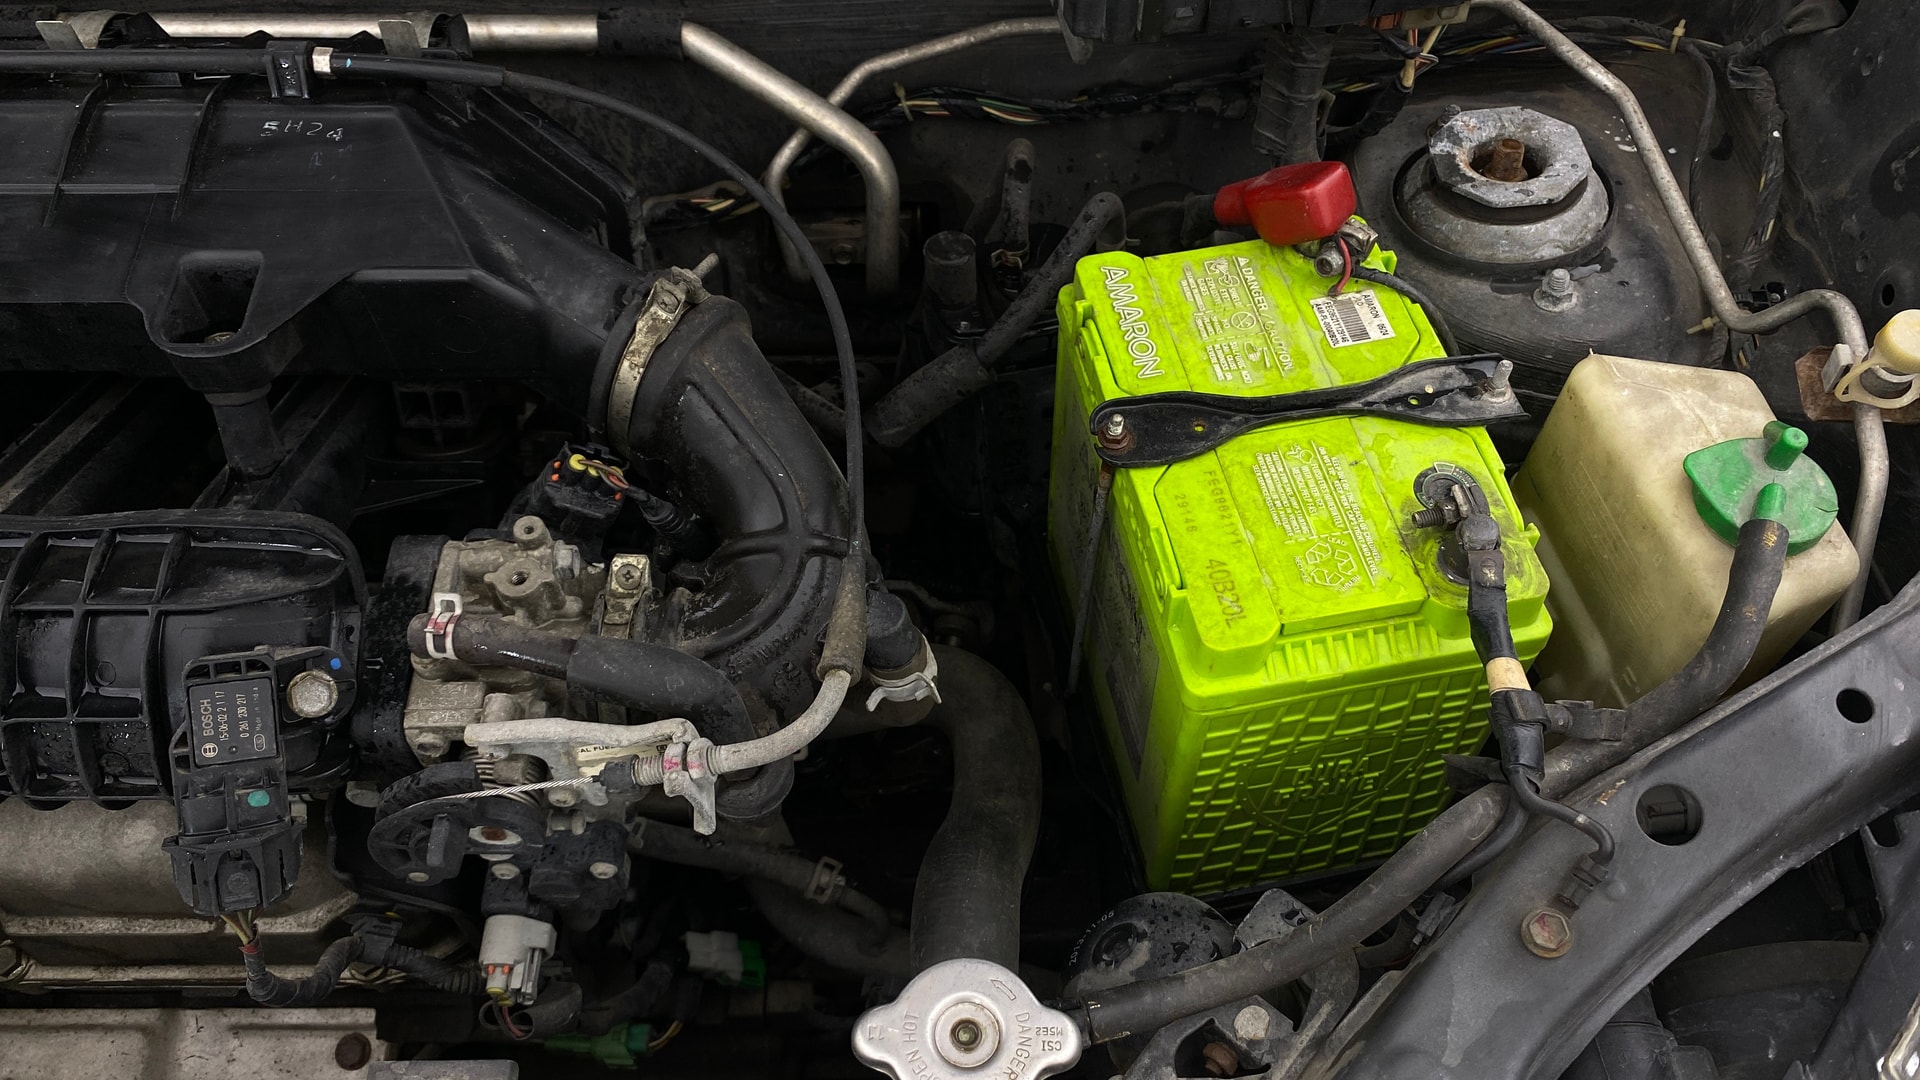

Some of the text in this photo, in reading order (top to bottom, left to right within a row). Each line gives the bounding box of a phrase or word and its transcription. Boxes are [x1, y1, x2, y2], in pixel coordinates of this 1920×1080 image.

[1361, 294, 1381, 318] AMARON
[1101, 265, 1165, 377] AMARON
[1220, 318, 1230, 328] NO
[1241, 267, 1269, 310] DANGER
[1262, 320, 1294, 369] CAUTION
[1317, 446, 1326, 454] DO
[1321, 455, 1331, 466] NOT
[1329, 456, 1342, 470] KEEP
[1332, 480, 1344, 494] KEEP
[1338, 494, 1350, 509] VENT
[1345, 492, 1356, 502] THE
[1174, 494, 1198, 533] 29146
[1345, 510, 1357, 524] CAPS
[1350, 503, 1365, 522] REACH
[1358, 522, 1369, 531] OF
[1352, 526, 1365, 543] TIGHT
[1359, 543, 1371, 556] AND
[1365, 557, 1379, 575] LEVEL
[1204, 557, 1247, 628] 40B20L
[236, 694, 246, 704] 217
[200, 698, 214, 736] BOSCH
[238, 720, 248, 730] 261
[902, 1010, 920, 1043] HOT
[1003, 1011, 1033, 1080] DANGER
[1041, 1040, 1062, 1052] CSI
